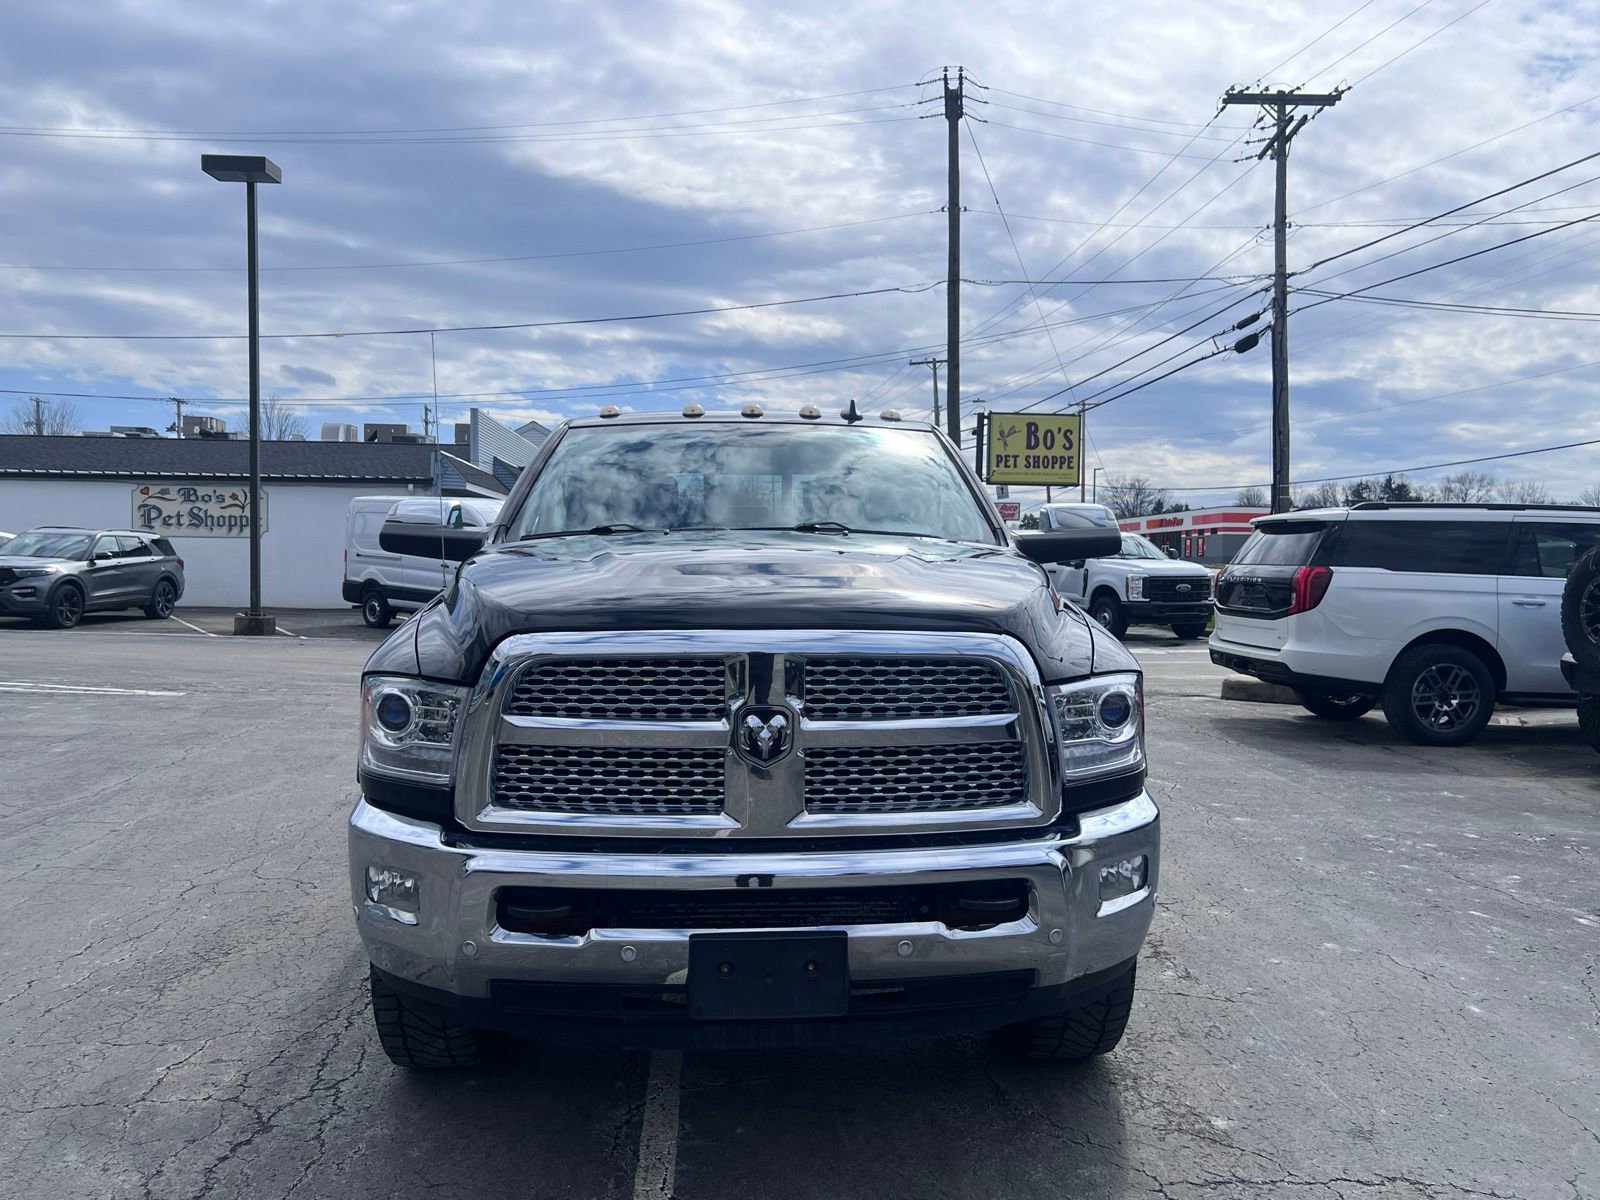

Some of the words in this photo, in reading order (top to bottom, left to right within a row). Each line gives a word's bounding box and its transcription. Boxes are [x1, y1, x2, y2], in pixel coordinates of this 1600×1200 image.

[995, 454, 1019, 469] PET
[1024, 455, 1074, 470] SHOPPE
[177, 487, 226, 503] Bo's
[137, 503, 184, 530] Pet
[187, 506, 262, 534] Shopp
